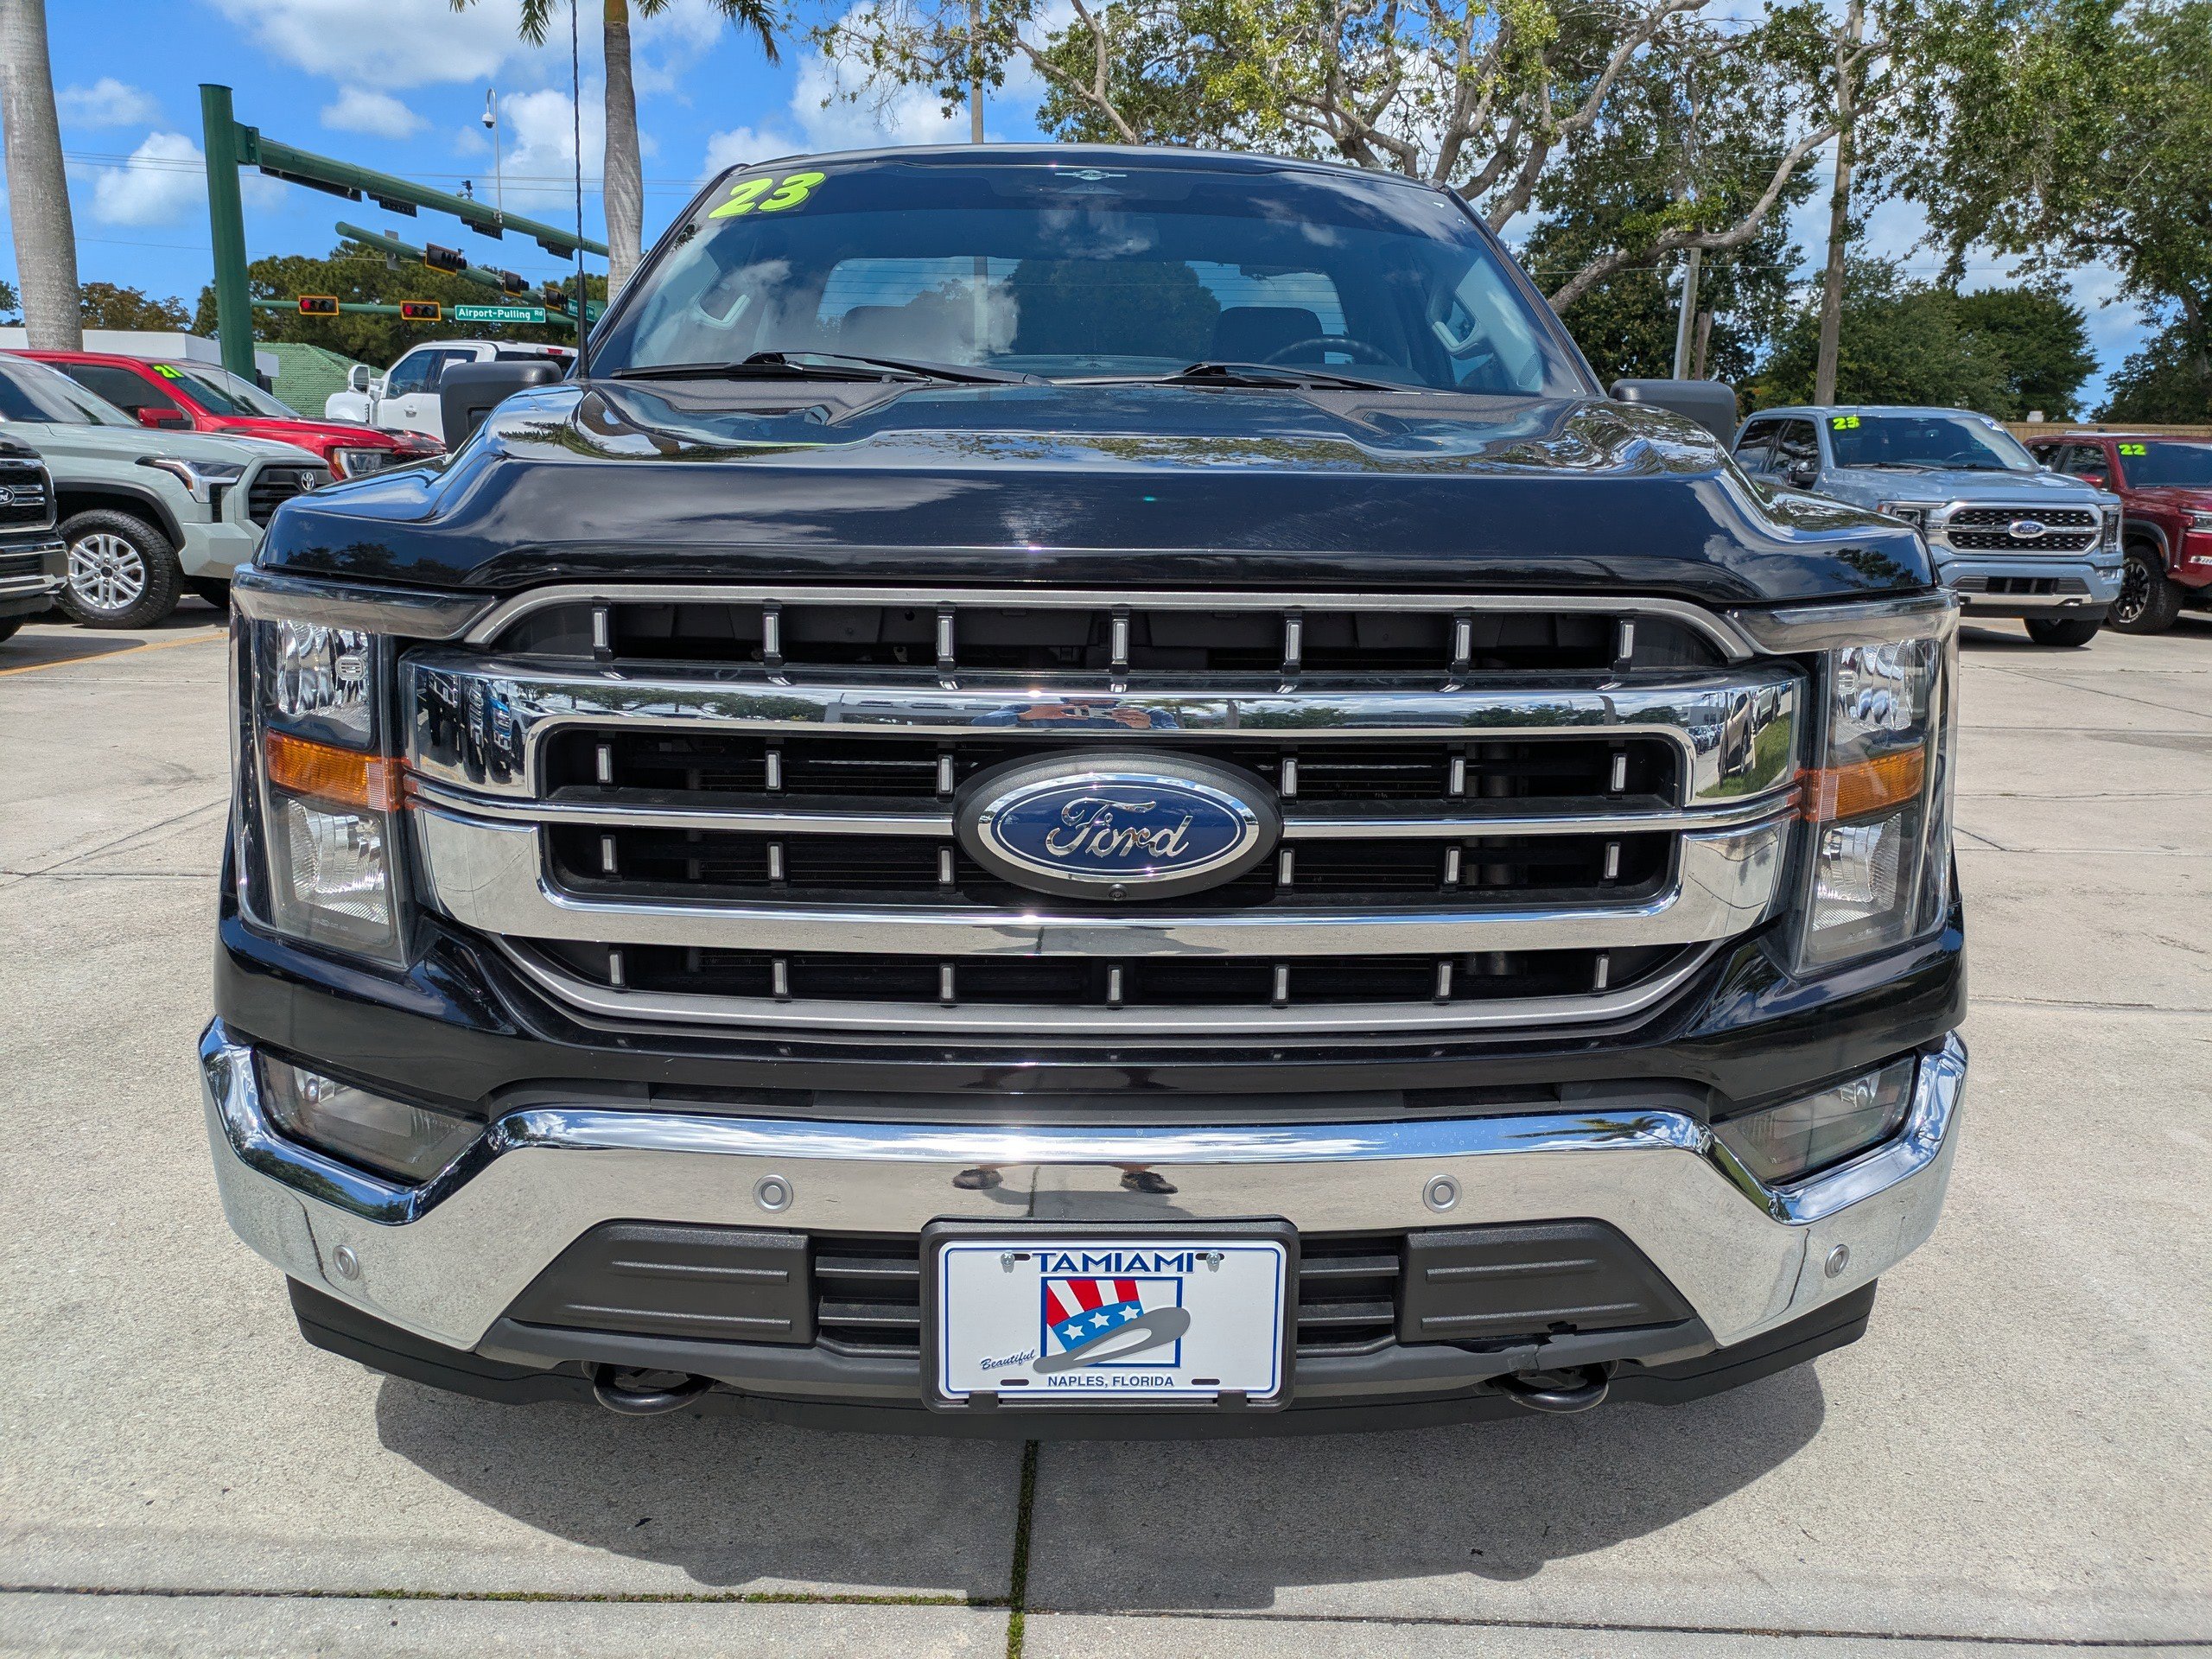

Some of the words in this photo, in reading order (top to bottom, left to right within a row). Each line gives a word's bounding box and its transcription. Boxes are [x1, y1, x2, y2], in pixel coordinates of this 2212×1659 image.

[709, 172, 827, 219] 23
[458, 308, 531, 321] Airport-Pulling
[153, 365, 184, 378] 21
[1833, 416, 1860, 430] 23
[2119, 444, 2146, 456] 22
[1046, 798, 1193, 858] Ford
[1032, 1252, 1194, 1273] TAMIAMI
[980, 1349, 1036, 1370] Beautiful
[1047, 1376, 1108, 1389] NAPLES,
[1112, 1376, 1174, 1387] FLORIDA
